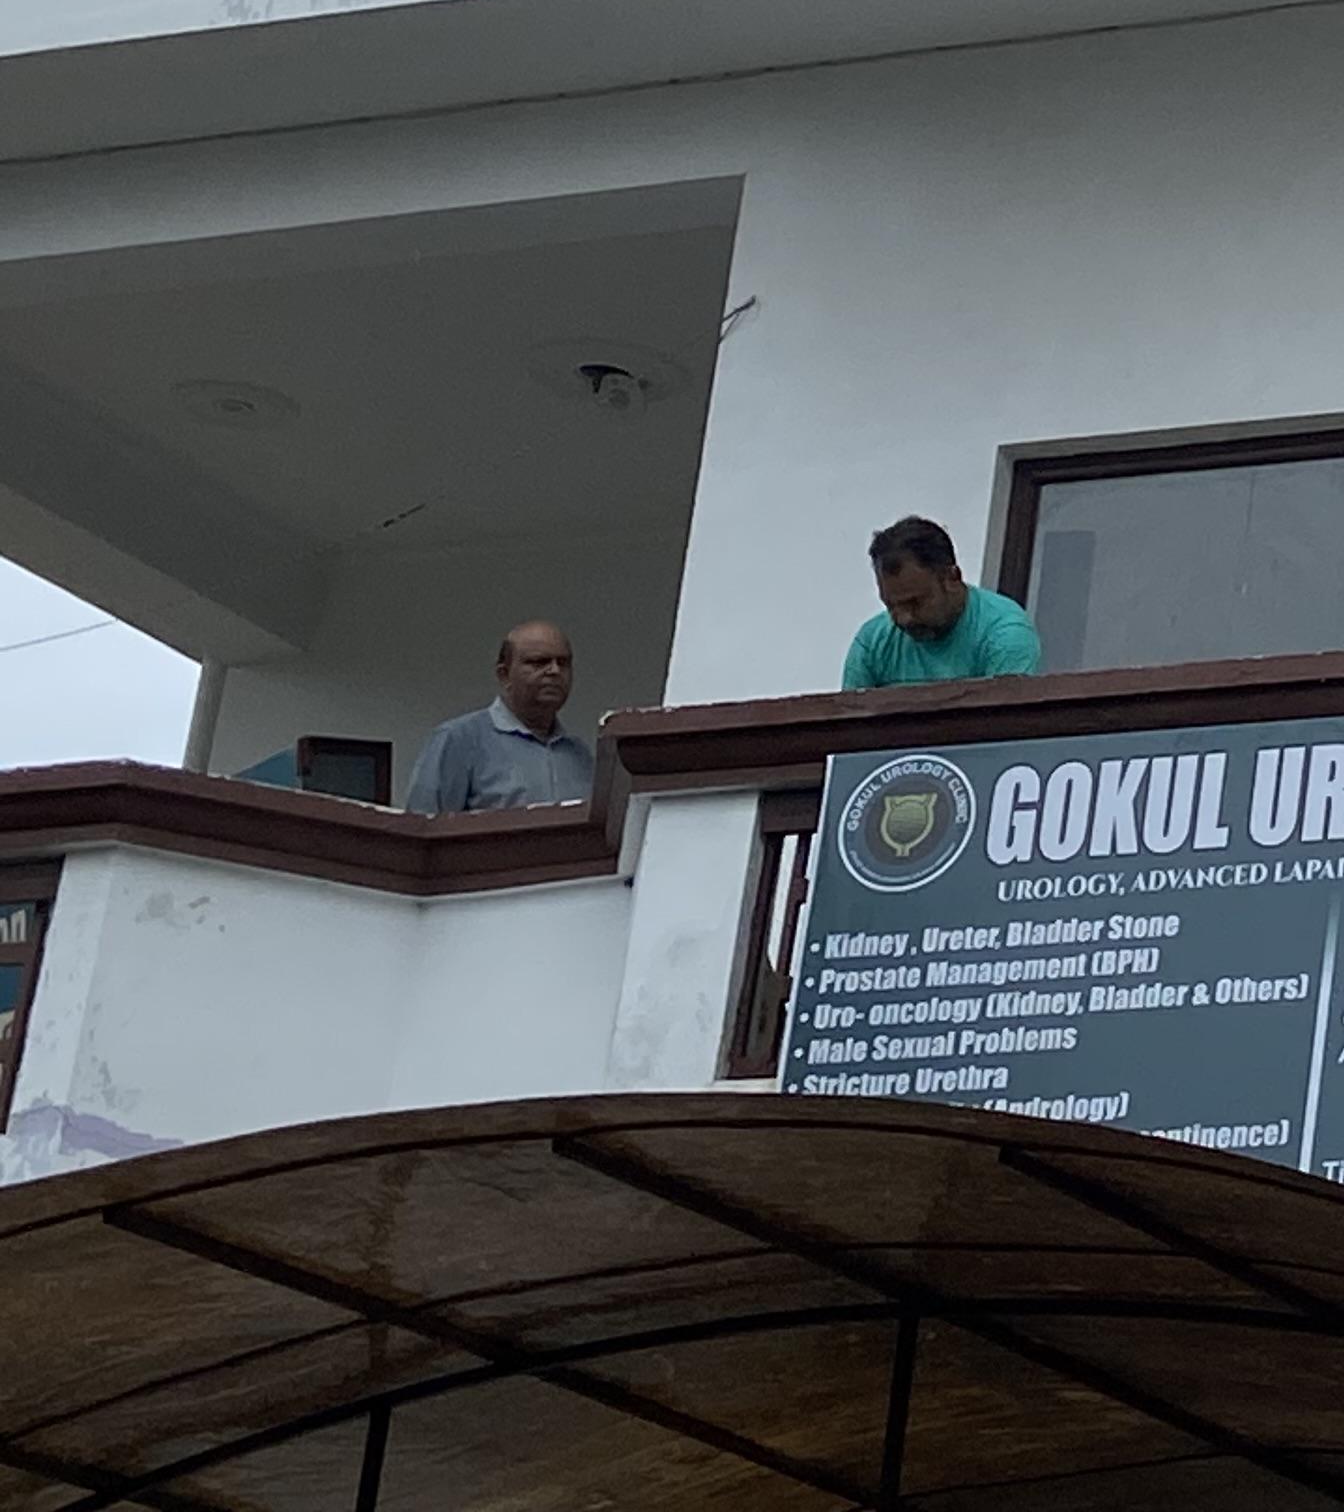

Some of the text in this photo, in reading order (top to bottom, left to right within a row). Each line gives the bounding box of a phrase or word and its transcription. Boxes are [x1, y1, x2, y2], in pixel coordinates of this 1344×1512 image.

[847, 761, 968, 831] GOKUL UROLOGY CLINIC
[986, 751, 1230, 866] GOKUL
[997, 871, 1125, 902] UROLOGY,
[1131, 863, 1266, 893] ADVANCED
[922, 926, 1001, 952] Ureter,
[1006, 917, 1104, 947] Bladder
[1108, 914, 1180, 940] Stone
[818, 947, 1160, 994] Prostate Management (BPH)
[986, 990, 1084, 1018] (Kidney,
[1088, 982, 1189, 1012] Bladder
[1192, 982, 1210, 1006] &
[1215, 974, 1309, 1004] Others)
[807, 1027, 1077, 1065] Male Sexual Problems
[803, 1065, 1008, 1096] Stricture Urethra
